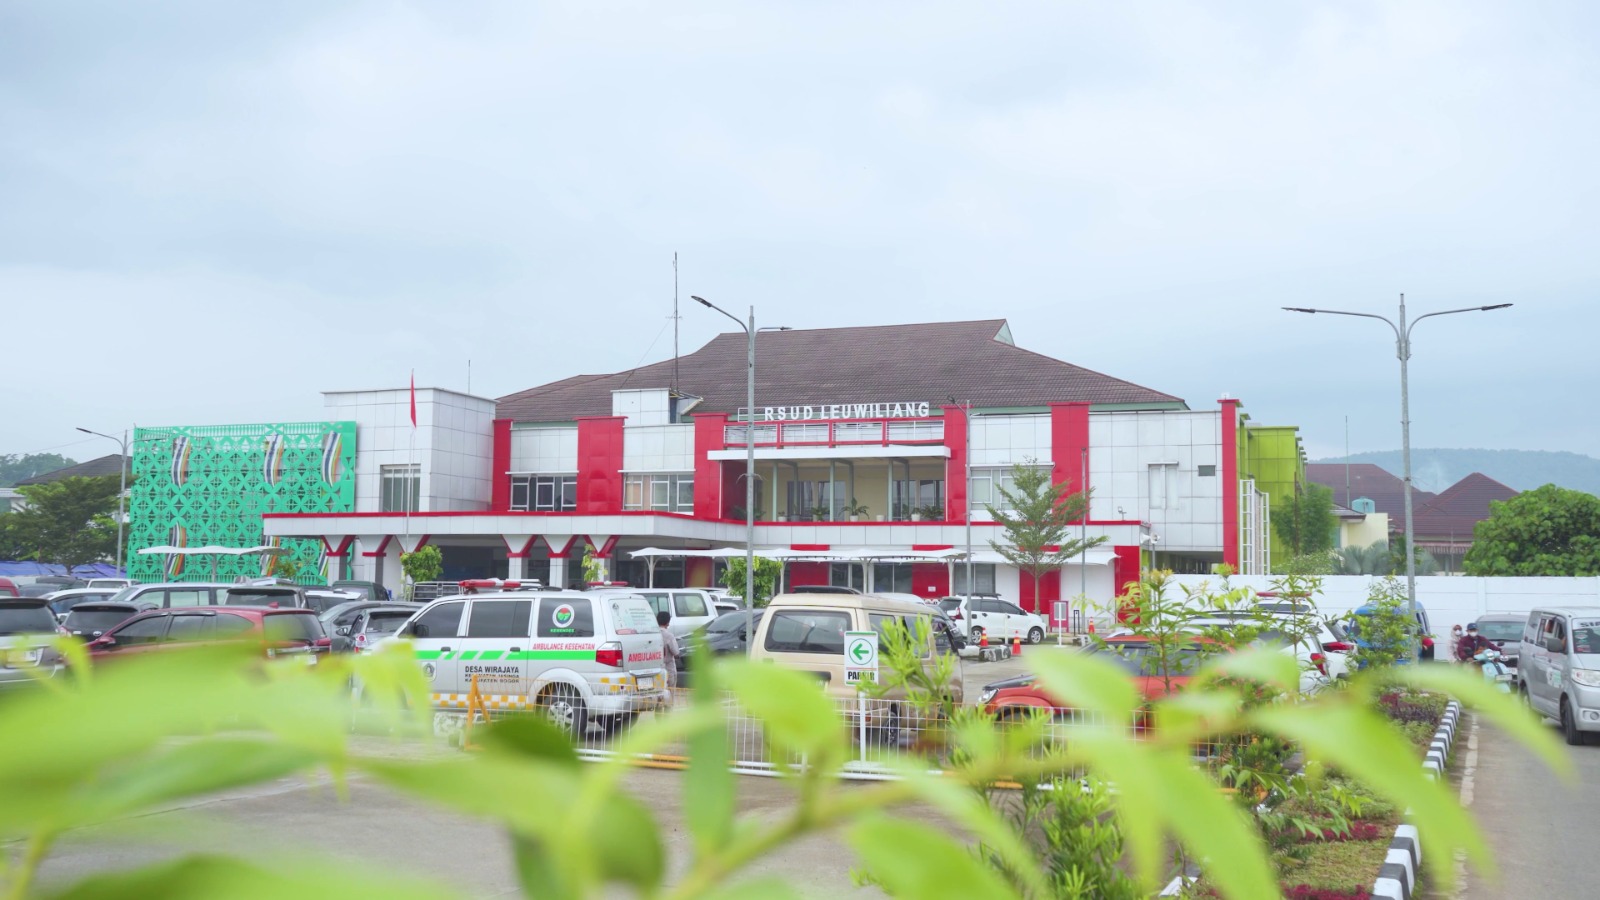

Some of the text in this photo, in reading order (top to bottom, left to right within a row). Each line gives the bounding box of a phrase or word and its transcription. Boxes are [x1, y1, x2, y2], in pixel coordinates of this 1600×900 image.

[764, 402, 930, 421] RSUD LEUWILIANG
[628, 651, 662, 662] AMBULANCE
